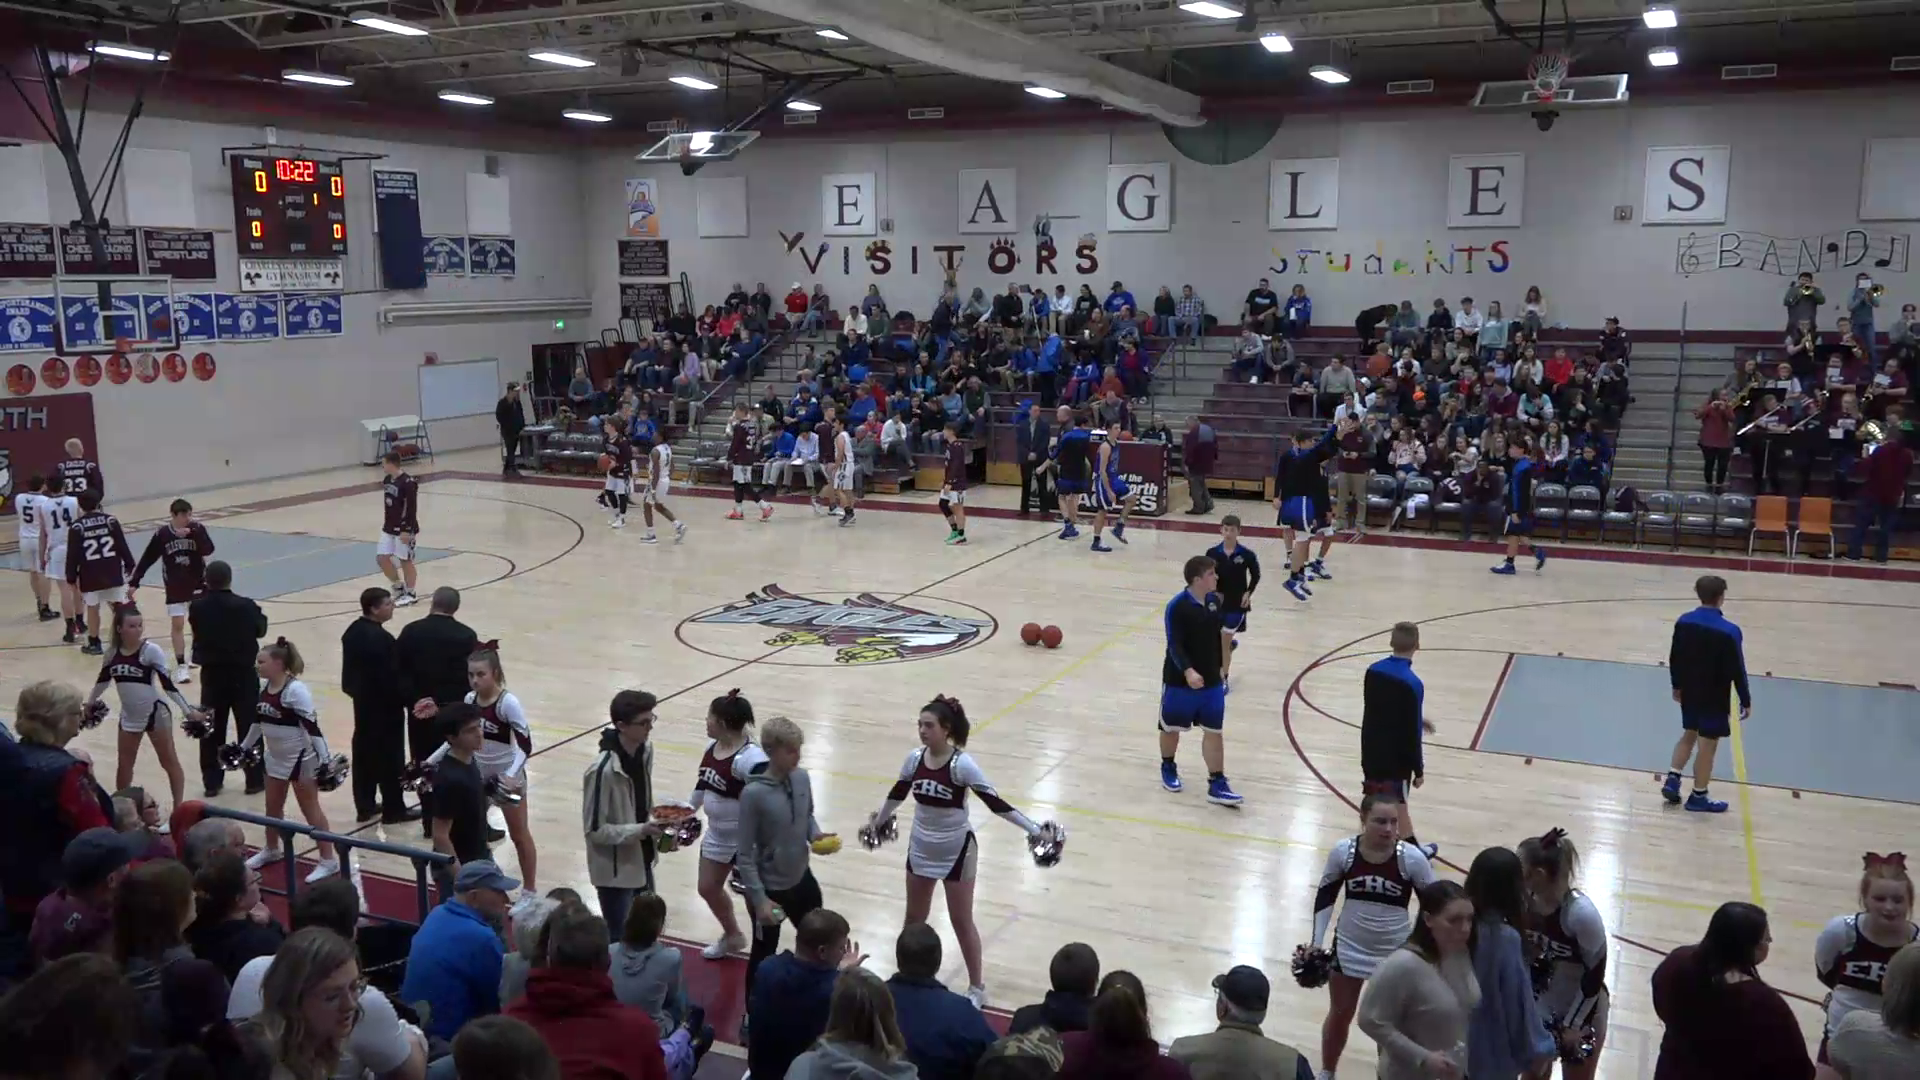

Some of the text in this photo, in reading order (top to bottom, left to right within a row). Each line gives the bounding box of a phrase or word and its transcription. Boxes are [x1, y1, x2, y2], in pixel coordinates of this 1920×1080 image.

[254, 170, 267, 192] 0
[276, 159, 314, 182] 10:22
[330, 176, 342, 196] 0
[251, 221, 262, 237] 0
[333, 223, 342, 239] 0
[152, 250, 209, 260] WRESTLING
[800, 243, 1098, 275] VISITORS
[1716, 229, 1870, 277] BAND
[1128, 473, 1142, 482] the
[23, 506, 34, 524] 5
[51, 507, 73, 529] 14
[83, 536, 116, 561] 22
[690, 597, 990, 637] EAGLES
[911, 779, 953, 800] EHS
[1348, 875, 1403, 898] EHS
